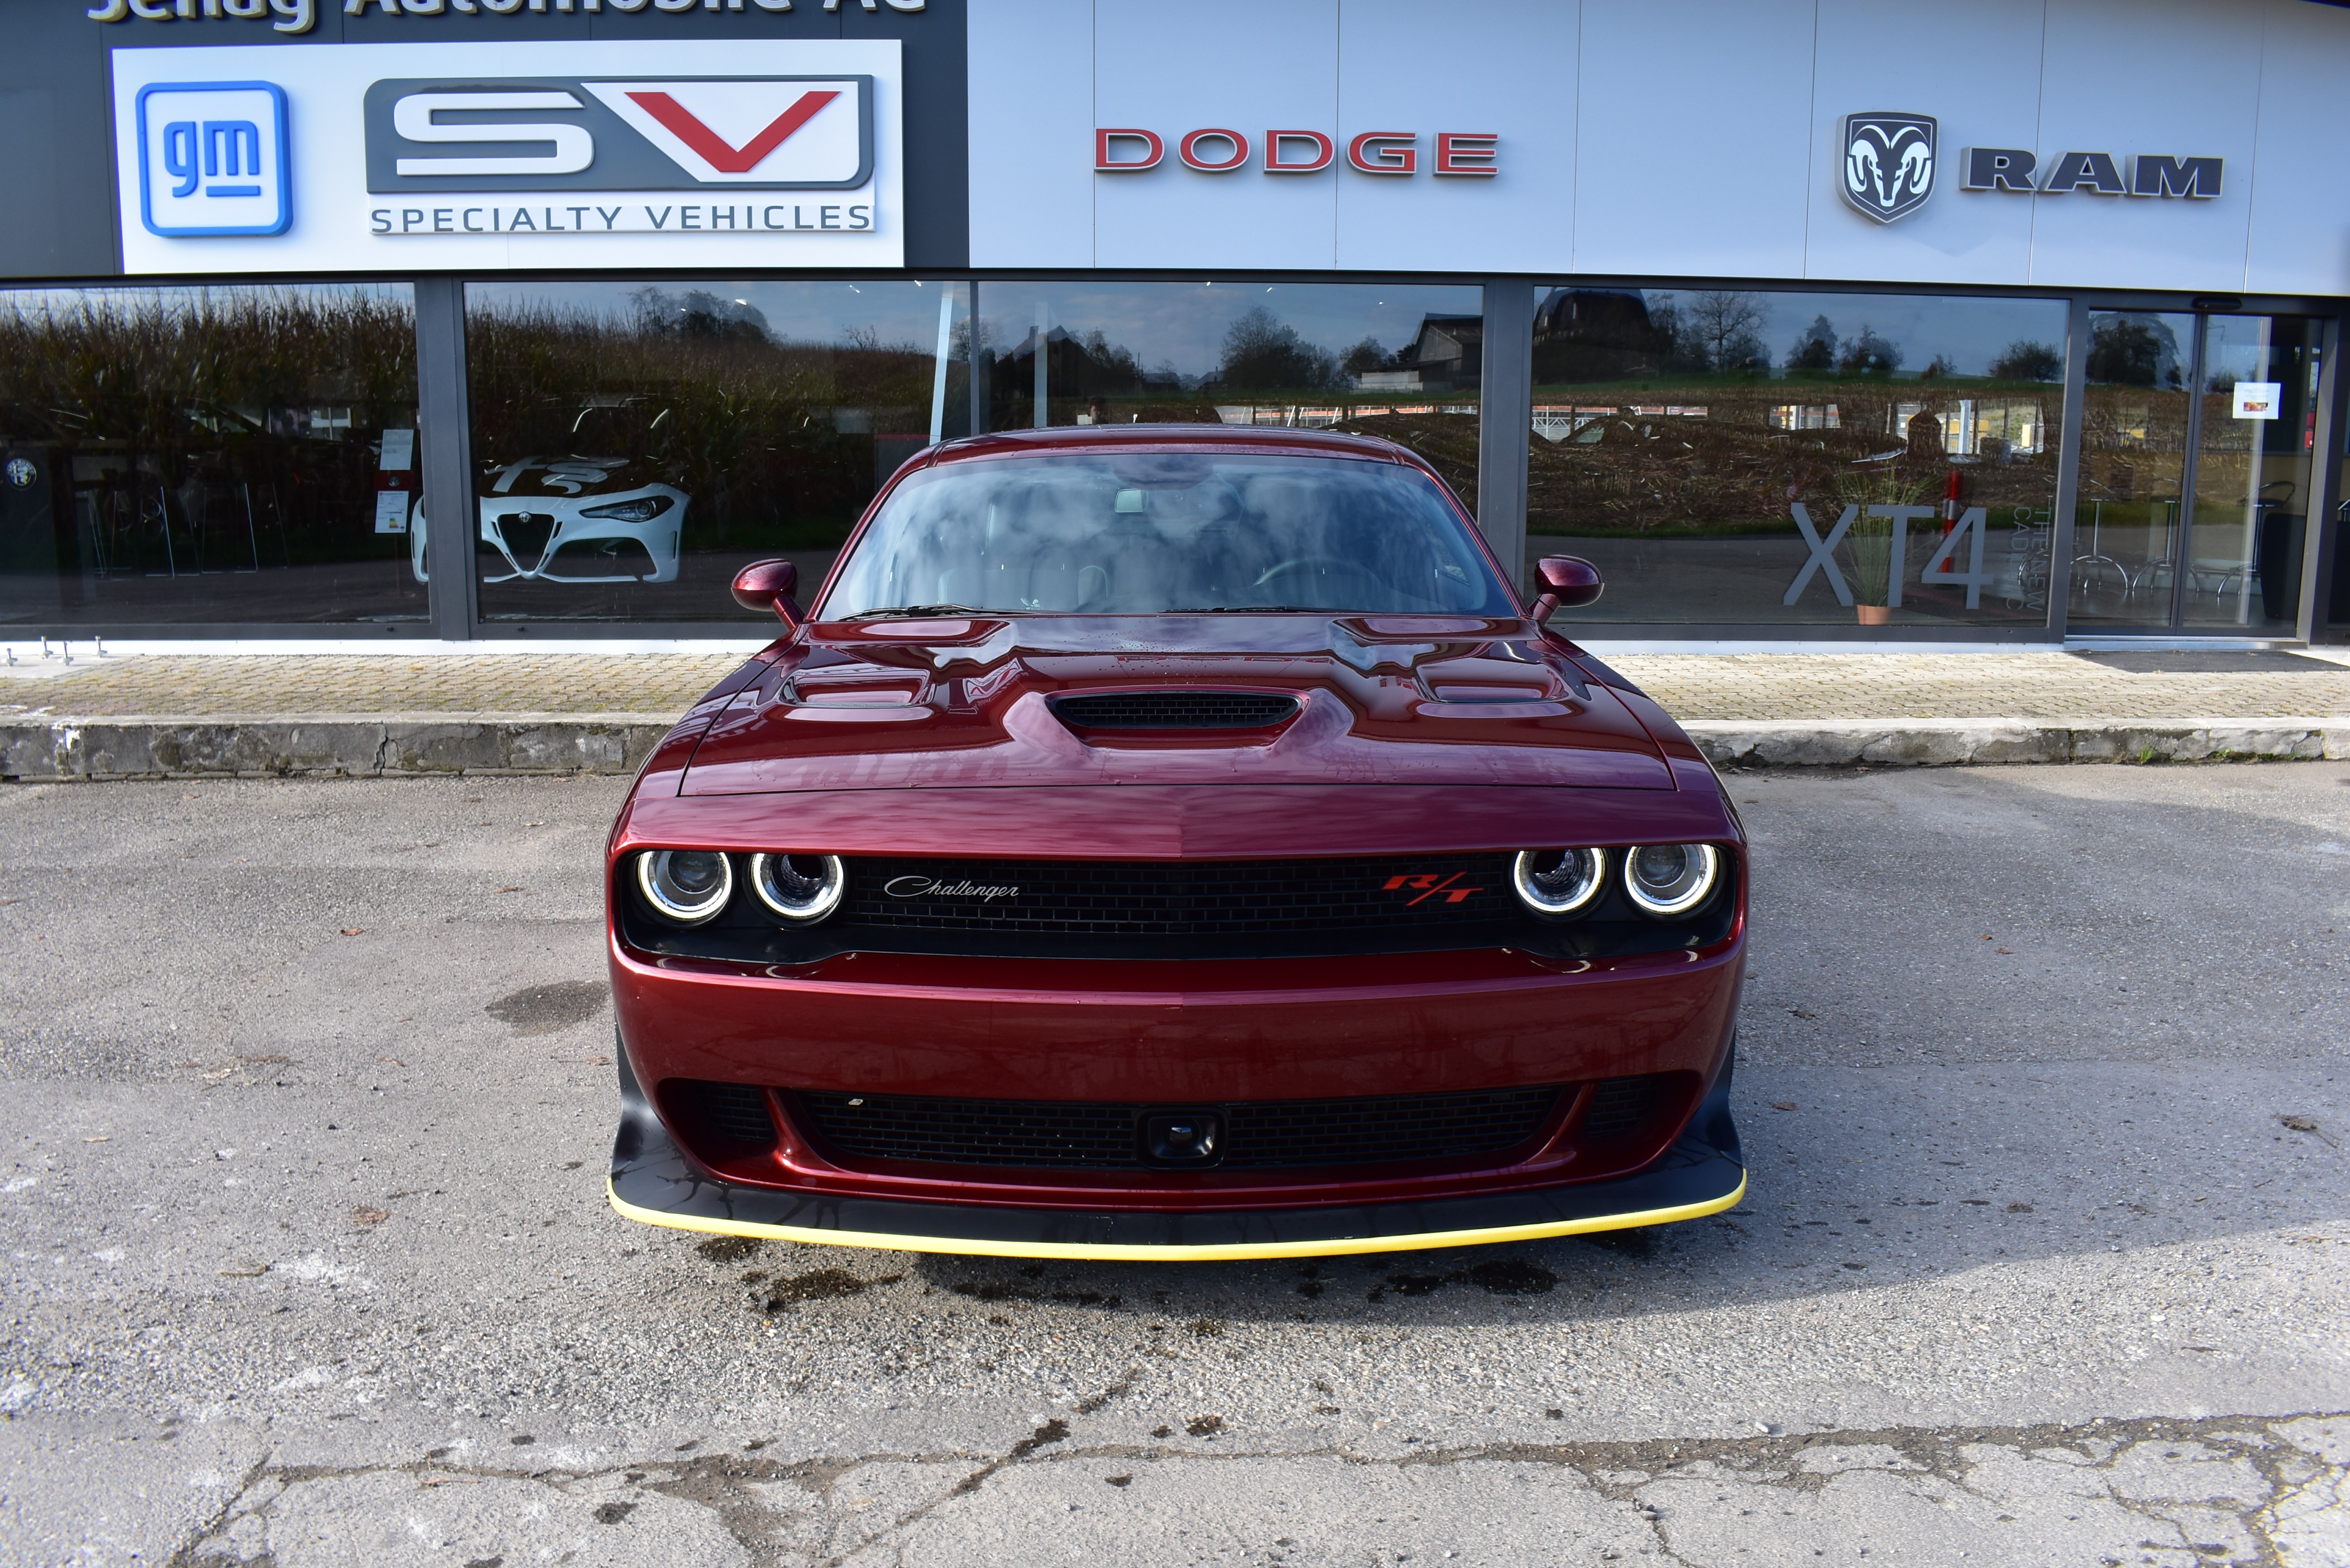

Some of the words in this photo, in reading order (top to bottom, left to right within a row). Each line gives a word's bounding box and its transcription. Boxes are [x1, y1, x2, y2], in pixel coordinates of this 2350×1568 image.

[163, 121, 260, 198] gm
[394, 90, 843, 178] SV
[1094, 128, 1499, 175] DODGE
[1961, 147, 2225, 198] RAM
[372, 206, 623, 233] SPECIALTY
[644, 205, 870, 230] VEHICLES
[2032, 507, 2052, 549] THE
[1783, 502, 1994, 609] XT4
[2006, 506, 2032, 609] CADILC
[2026, 560, 2047, 611] NEW
[884, 874, 1019, 903] Challenger
[1381, 871, 1485, 906] R/T
